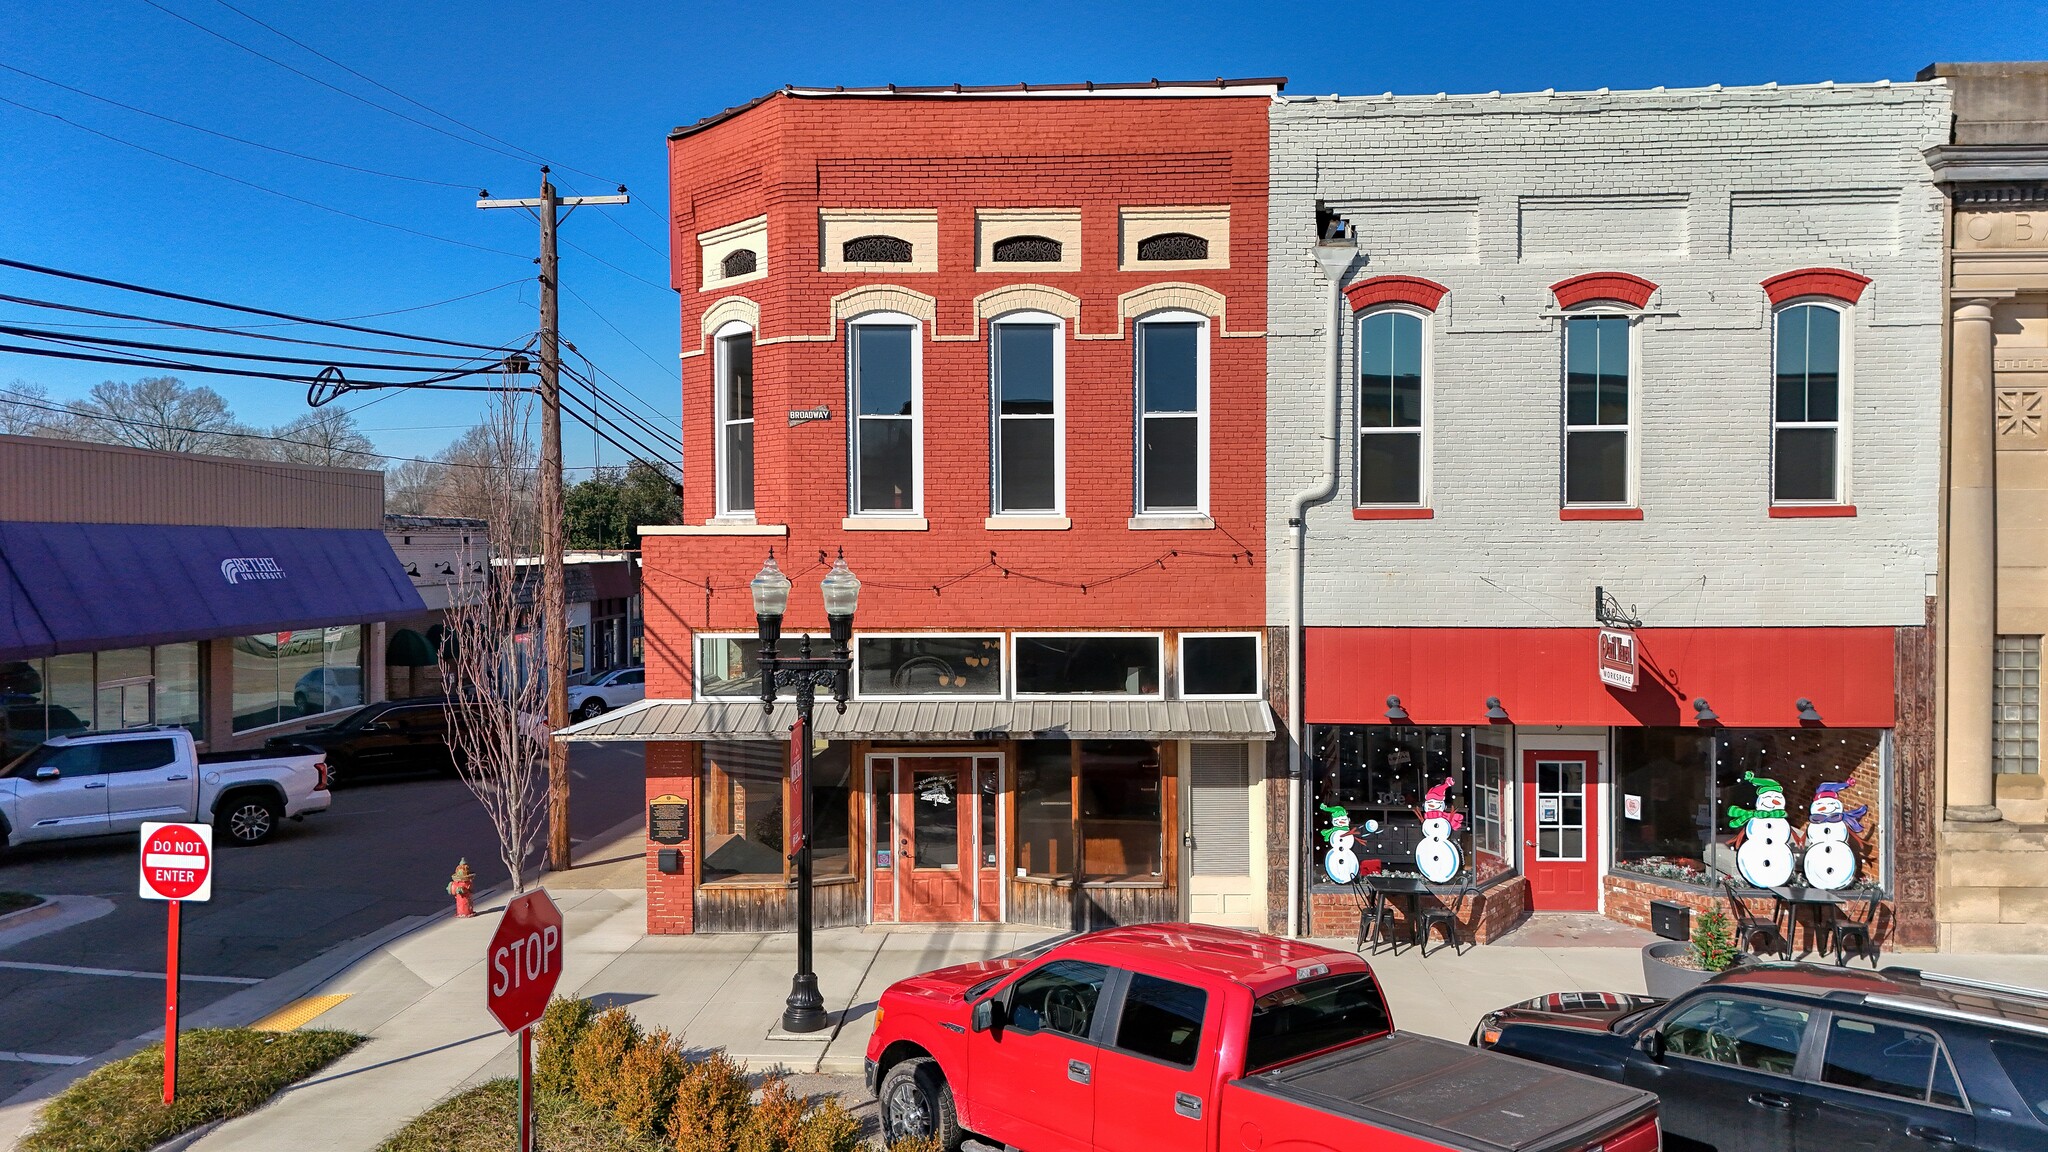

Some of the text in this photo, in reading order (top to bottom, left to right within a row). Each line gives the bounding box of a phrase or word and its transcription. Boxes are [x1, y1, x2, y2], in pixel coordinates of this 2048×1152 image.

[789, 411, 829, 419] BROADWAY
[234, 557, 283, 573] BETHEL
[1603, 670, 1632, 685] WORKSPACE
[153, 840, 202, 853] DO NOT
[155, 869, 194, 882] ENTER
[493, 925, 558, 997] STOP
